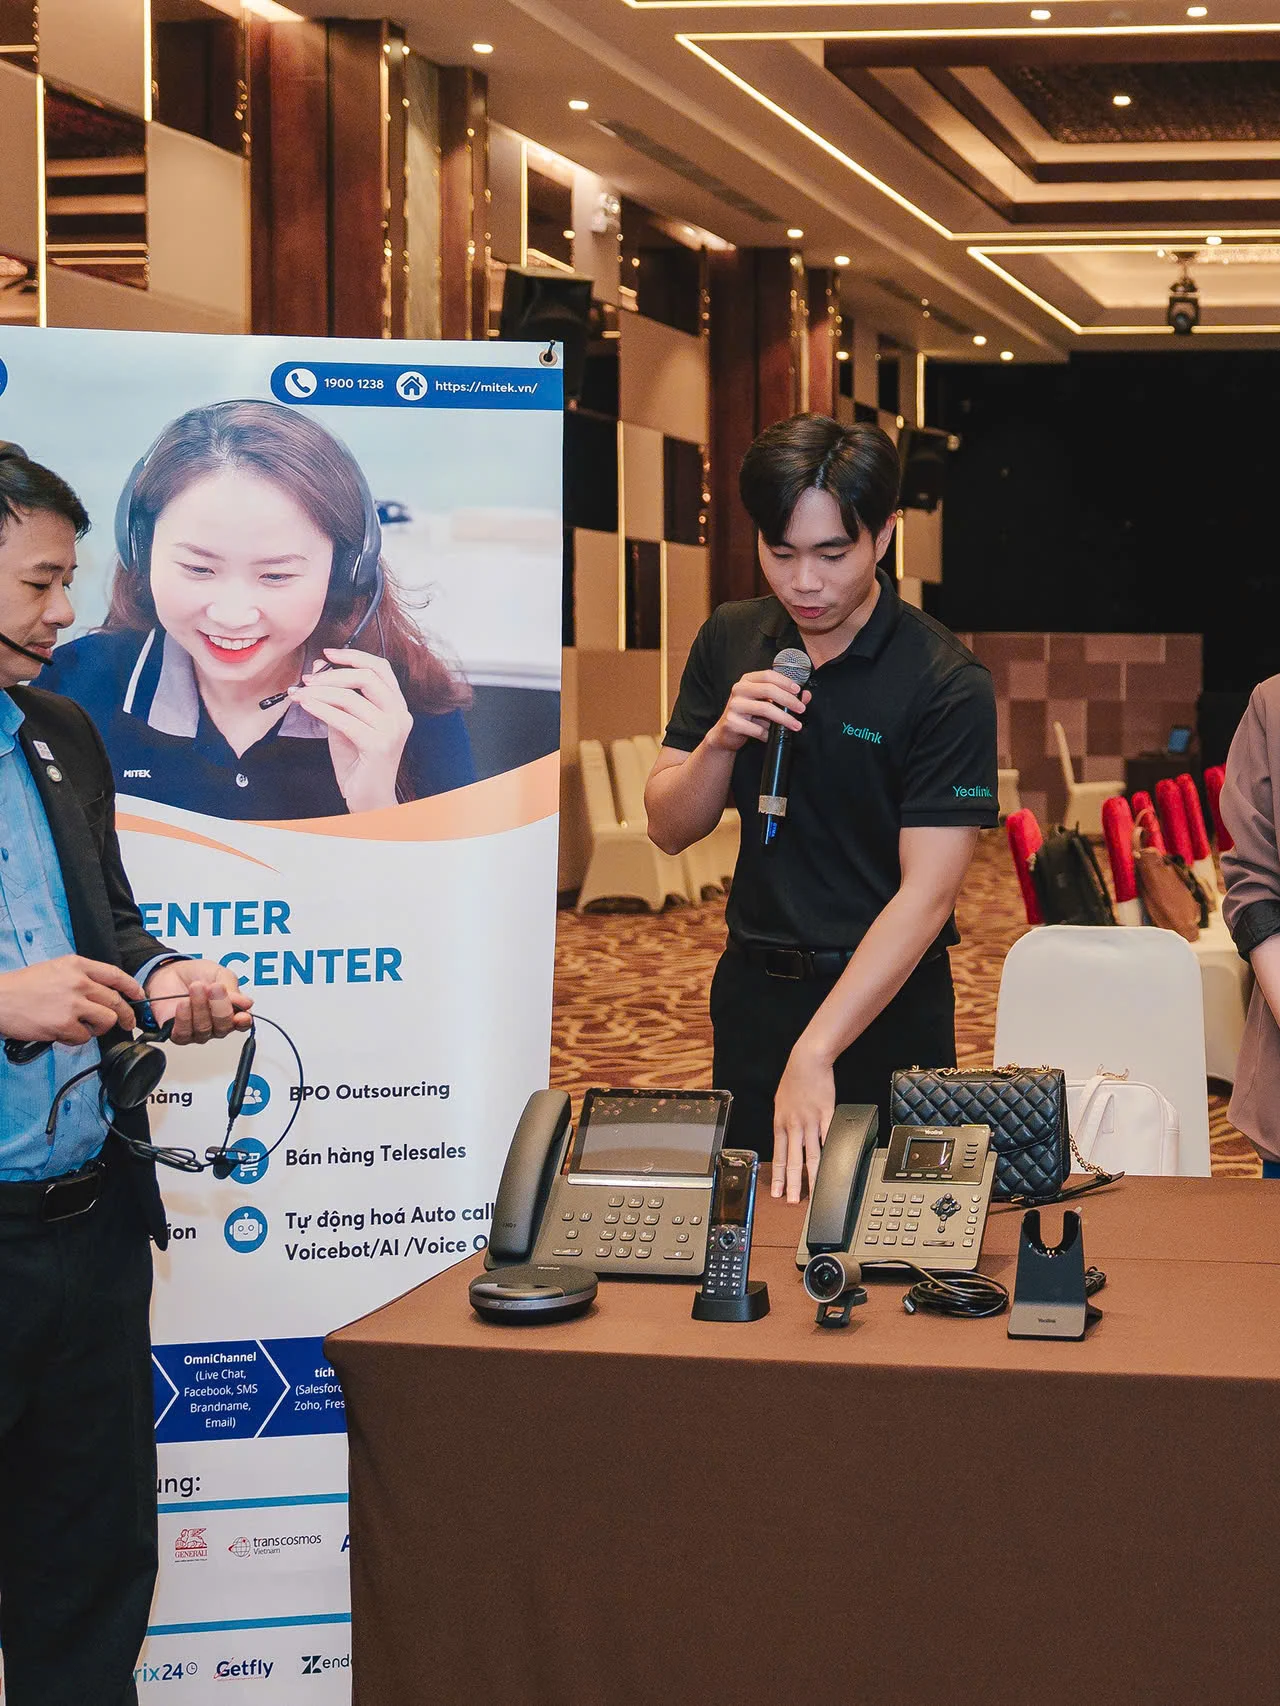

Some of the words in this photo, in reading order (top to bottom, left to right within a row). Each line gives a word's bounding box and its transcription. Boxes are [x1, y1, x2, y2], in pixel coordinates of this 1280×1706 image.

[324, 378, 353, 389] 1900
[358, 379, 384, 390] 1238
[435, 381, 538, 394] https://mitek.vn/
[842, 721, 883, 744] Yealink
[123, 769, 152, 778] MITEK
[953, 785, 992, 798] Yealink
[138, 899, 292, 938] ENTER
[218, 947, 403, 987] CENTER
[289, 1085, 331, 1102] BPO
[336, 1081, 451, 1101] Outsourcing
[285, 1149, 324, 1167] Bán
[327, 1147, 375, 1167] hàng
[380, 1142, 467, 1163] Telesales
[285, 1212, 311, 1235] Tự
[317, 1210, 365, 1234] động
[370, 1207, 405, 1226] hoá
[411, 1206, 457, 1224] Auto
[461, 1202, 494, 1221] call
[167, 1223, 197, 1240] ion
[285, 1237, 400, 1262] Voicebot/AI
[473, 1234, 488, 1251] O
[184, 1352, 257, 1365] OmniChannel
[195, 1370, 219, 1382] (Live
[221, 1369, 247, 1380] Chat,
[314, 1367, 335, 1378] tích
[184, 1386, 234, 1398] Facebook,
[236, 1384, 258, 1395] SMS
[295, 1385, 343, 1397] (Salesforc
[190, 1402, 252, 1414] Brandname,
[294, 1400, 322, 1412] Zoho,
[325, 1399, 345, 1409] Fres
[205, 1417, 236, 1429] Email)
[253, 1533, 322, 1548] transcosmos
[174, 1549, 208, 1558] GENERALI
[254, 1547, 281, 1555] Vietnam
[216, 1658, 274, 1679] Getfly
[301, 1653, 352, 1675] Zend
[134, 1662, 184, 1682] rix24
